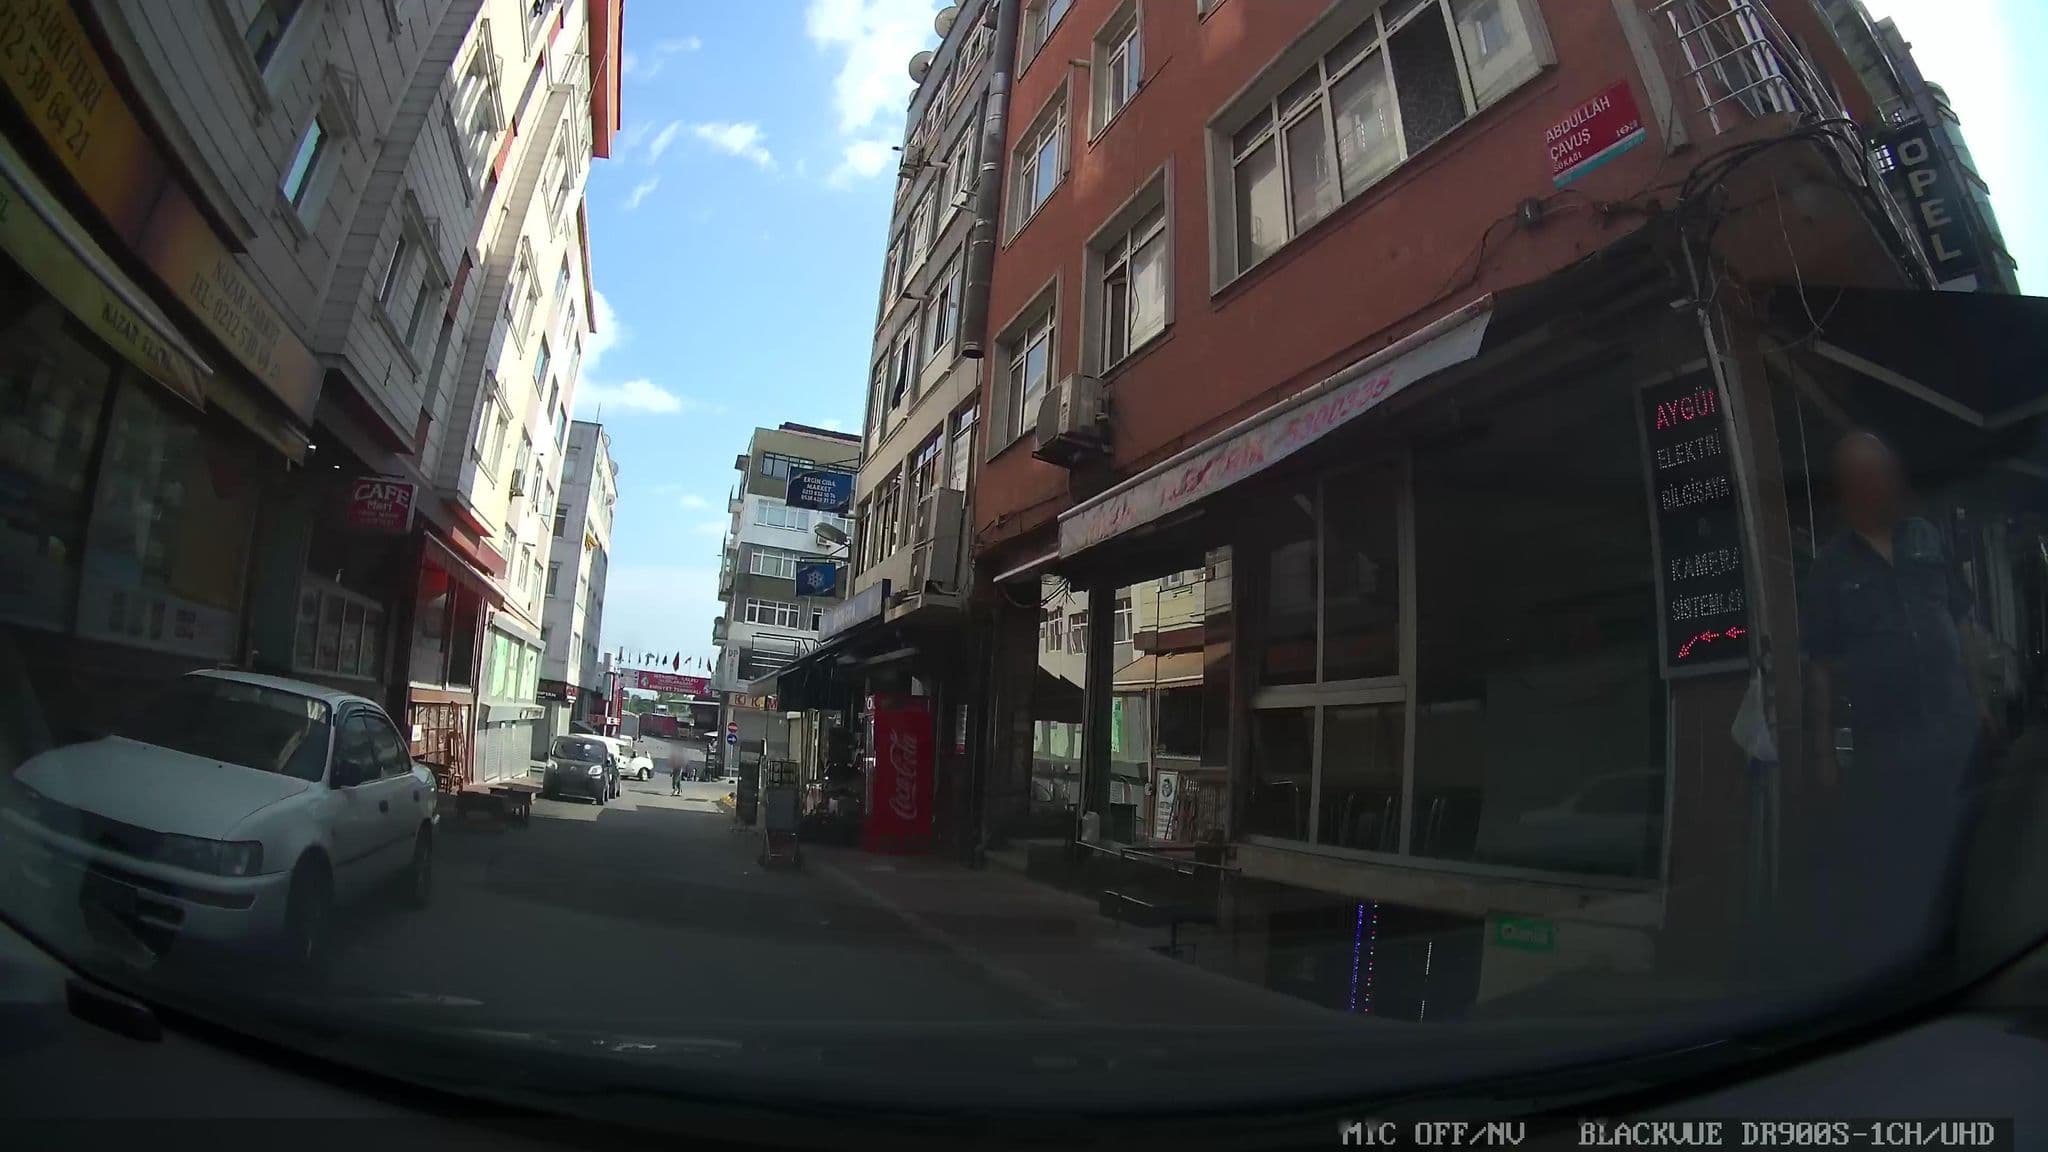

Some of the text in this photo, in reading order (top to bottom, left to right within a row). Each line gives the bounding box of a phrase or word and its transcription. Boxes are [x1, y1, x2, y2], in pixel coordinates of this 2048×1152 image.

[1550, 128, 1591, 162] ÇAVUŞ
[1896, 137, 1962, 262] OPEL
[354, 483, 410, 508] CAFE
[888, 728, 919, 820] Coca-Cola
